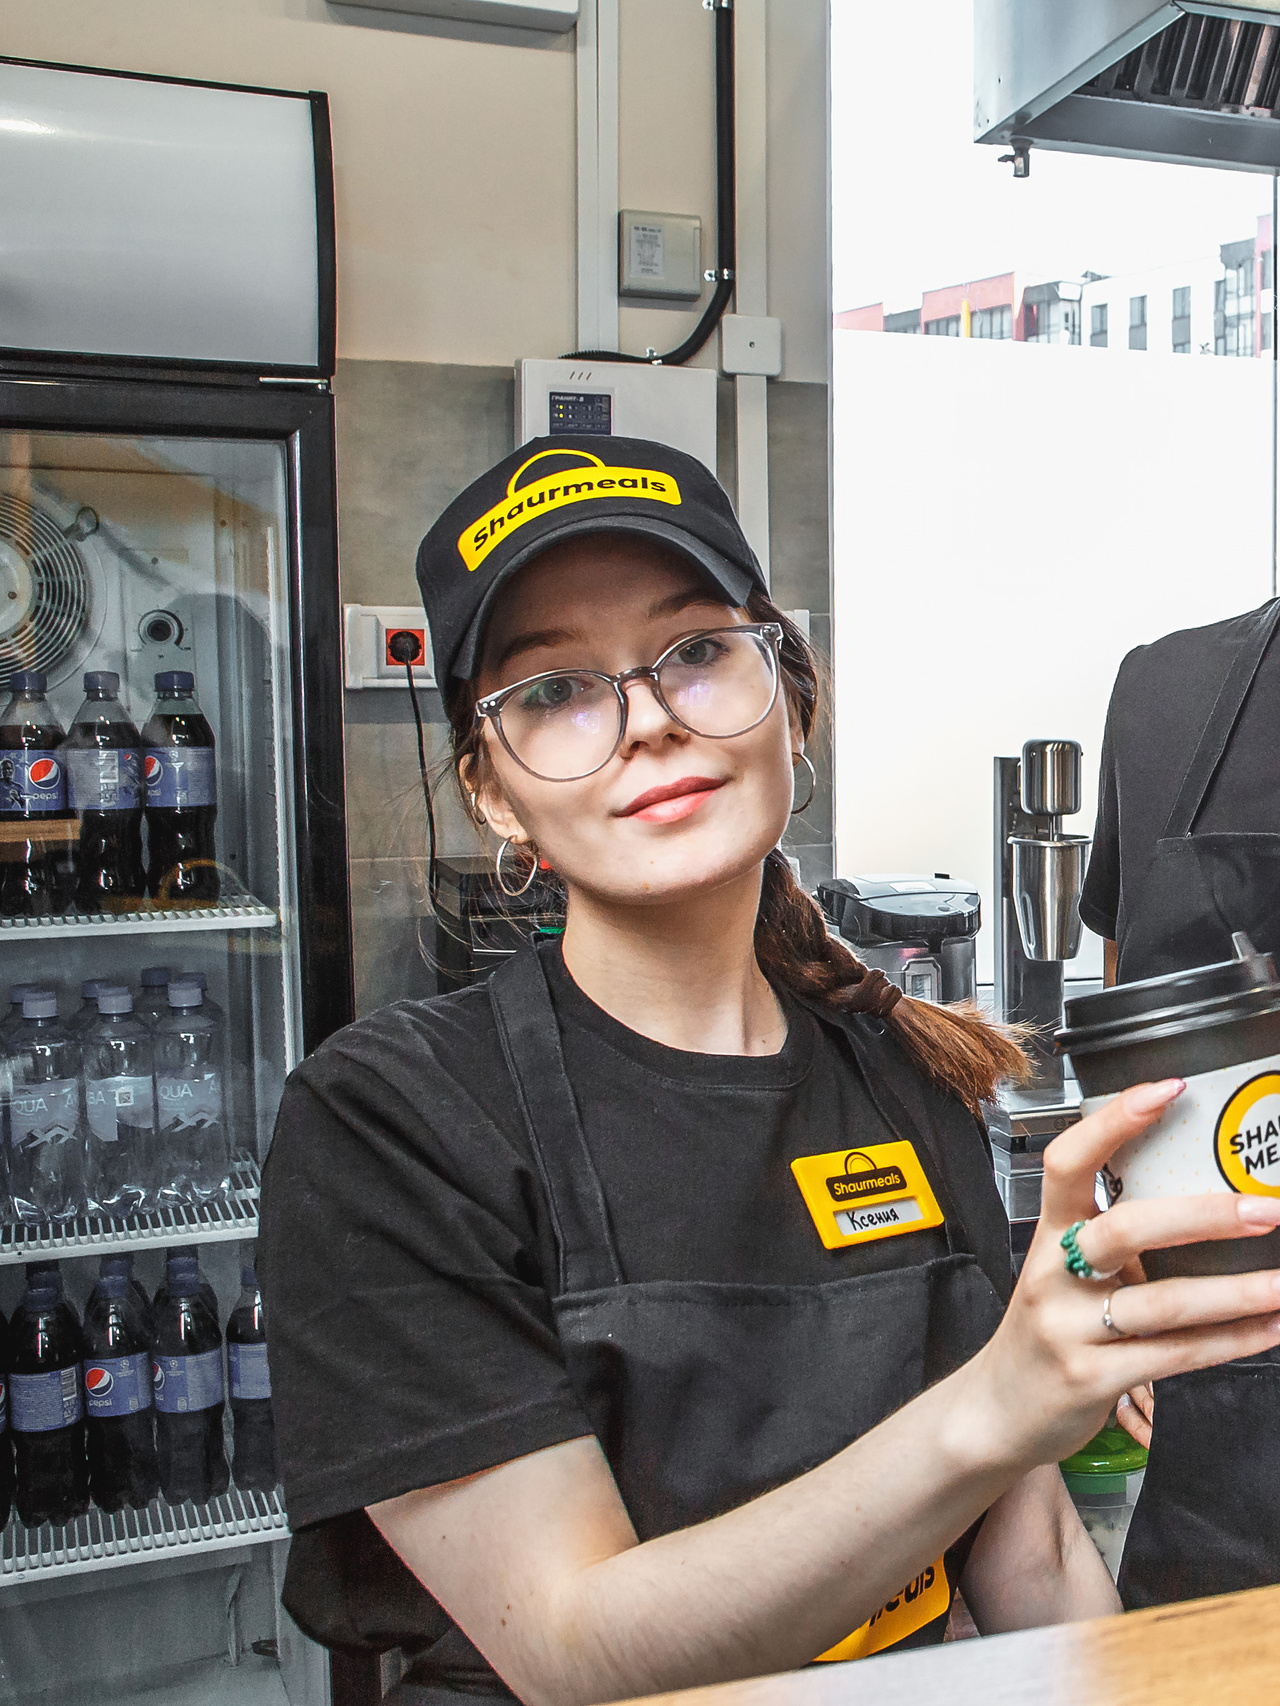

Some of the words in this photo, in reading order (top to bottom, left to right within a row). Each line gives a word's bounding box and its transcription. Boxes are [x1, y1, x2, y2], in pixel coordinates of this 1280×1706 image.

[473, 476, 667, 552] Shaurmeals
[833, 1172, 901, 1196] Shaurmeals
[845, 1207, 900, 1231] Ксения
